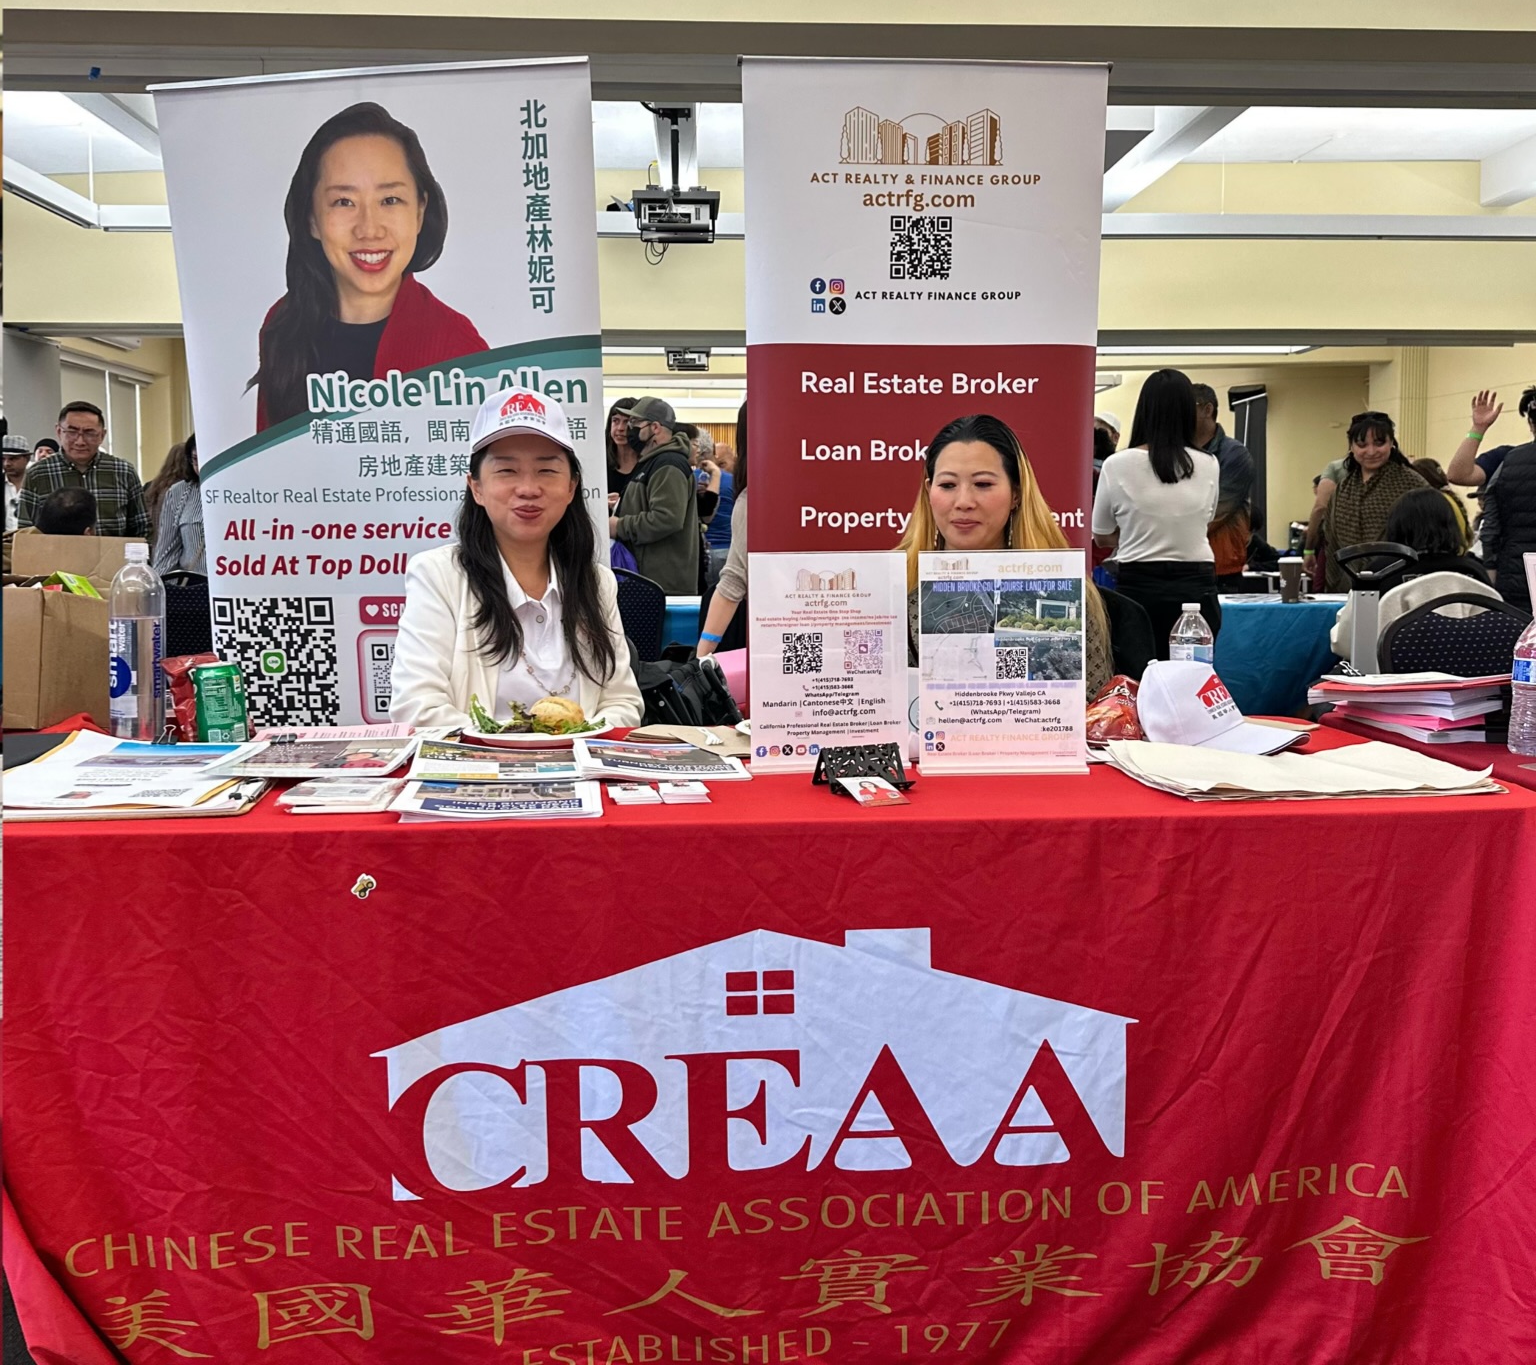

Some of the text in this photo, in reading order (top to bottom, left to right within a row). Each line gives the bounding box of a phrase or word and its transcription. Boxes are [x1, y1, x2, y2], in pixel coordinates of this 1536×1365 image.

[810, 172, 1042, 187] ACT REALTY & FINANCE GROUP
[520, 98, 556, 314] 北加地產林妮可
[862, 190, 975, 212] actrfg.com
[855, 290, 1021, 301] ACT REALTY FINANCE GROUP
[310, 375, 422, 410] Nicole
[434, 373, 485, 407] Lin
[801, 372, 1039, 395] Real Estate Broker
[801, 439, 929, 462] Loan Brok
[206, 485, 467, 506] SF Realtor Real Estate Professiona
[224, 517, 452, 541] All -in -one service
[801, 507, 910, 534] Property
[215, 554, 407, 580] Sold At Top Doll
[998, 563, 1063, 575] actrfg.com
[1058, 580, 1072, 591] SALE
[804, 599, 848, 608] actrfg.com
[152, 620, 162, 700] smartwater
[812, 708, 876, 717] info@actrfg.com
[970, 708, 1041, 716] (WhatsApp/Telegram)
[950, 734, 968, 742] ACT
[1002, 733, 1040, 741] FINANCE
[1041, 733, 1072, 741] GROUP
[388, 1038, 1126, 1197] CREAA
[64, 1162, 1410, 1278] CHINESE REAL ESTATE ASSOCIATION OF AMERICA
[100, 1214, 1432, 1360] 美國華人實業協會
[522, 1319, 1012, 1365] ESTABLISHED 1977
